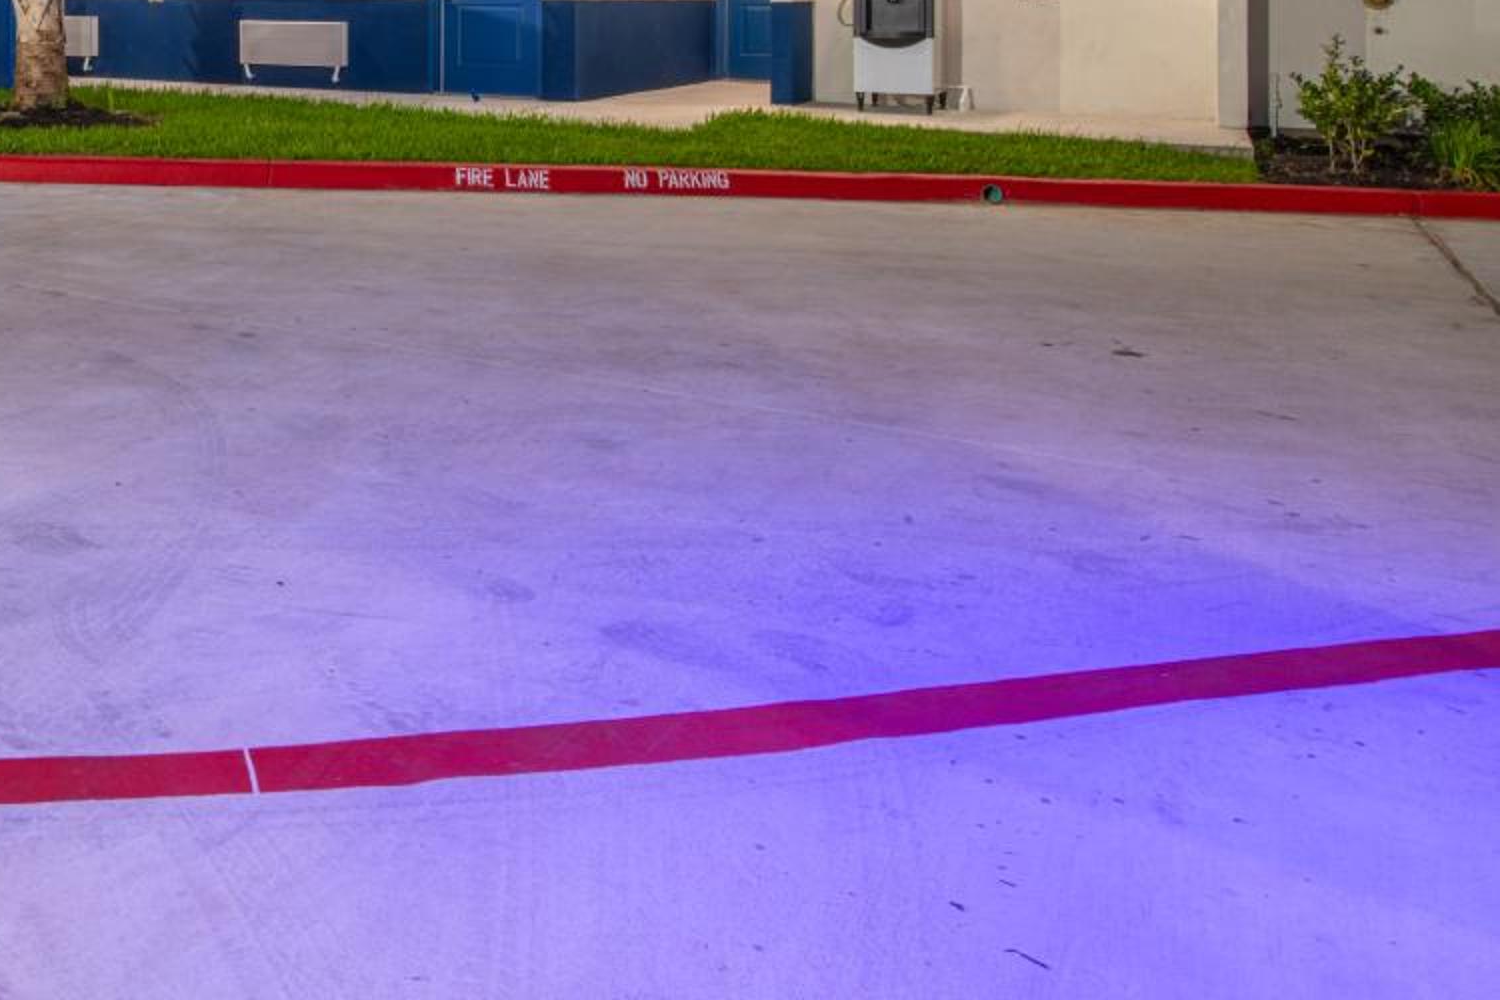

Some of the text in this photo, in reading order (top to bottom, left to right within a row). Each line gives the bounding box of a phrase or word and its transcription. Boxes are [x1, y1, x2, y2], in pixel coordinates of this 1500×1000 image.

[455, 167, 548, 189] FIRE LANE
[624, 168, 730, 189] NO PARKING
